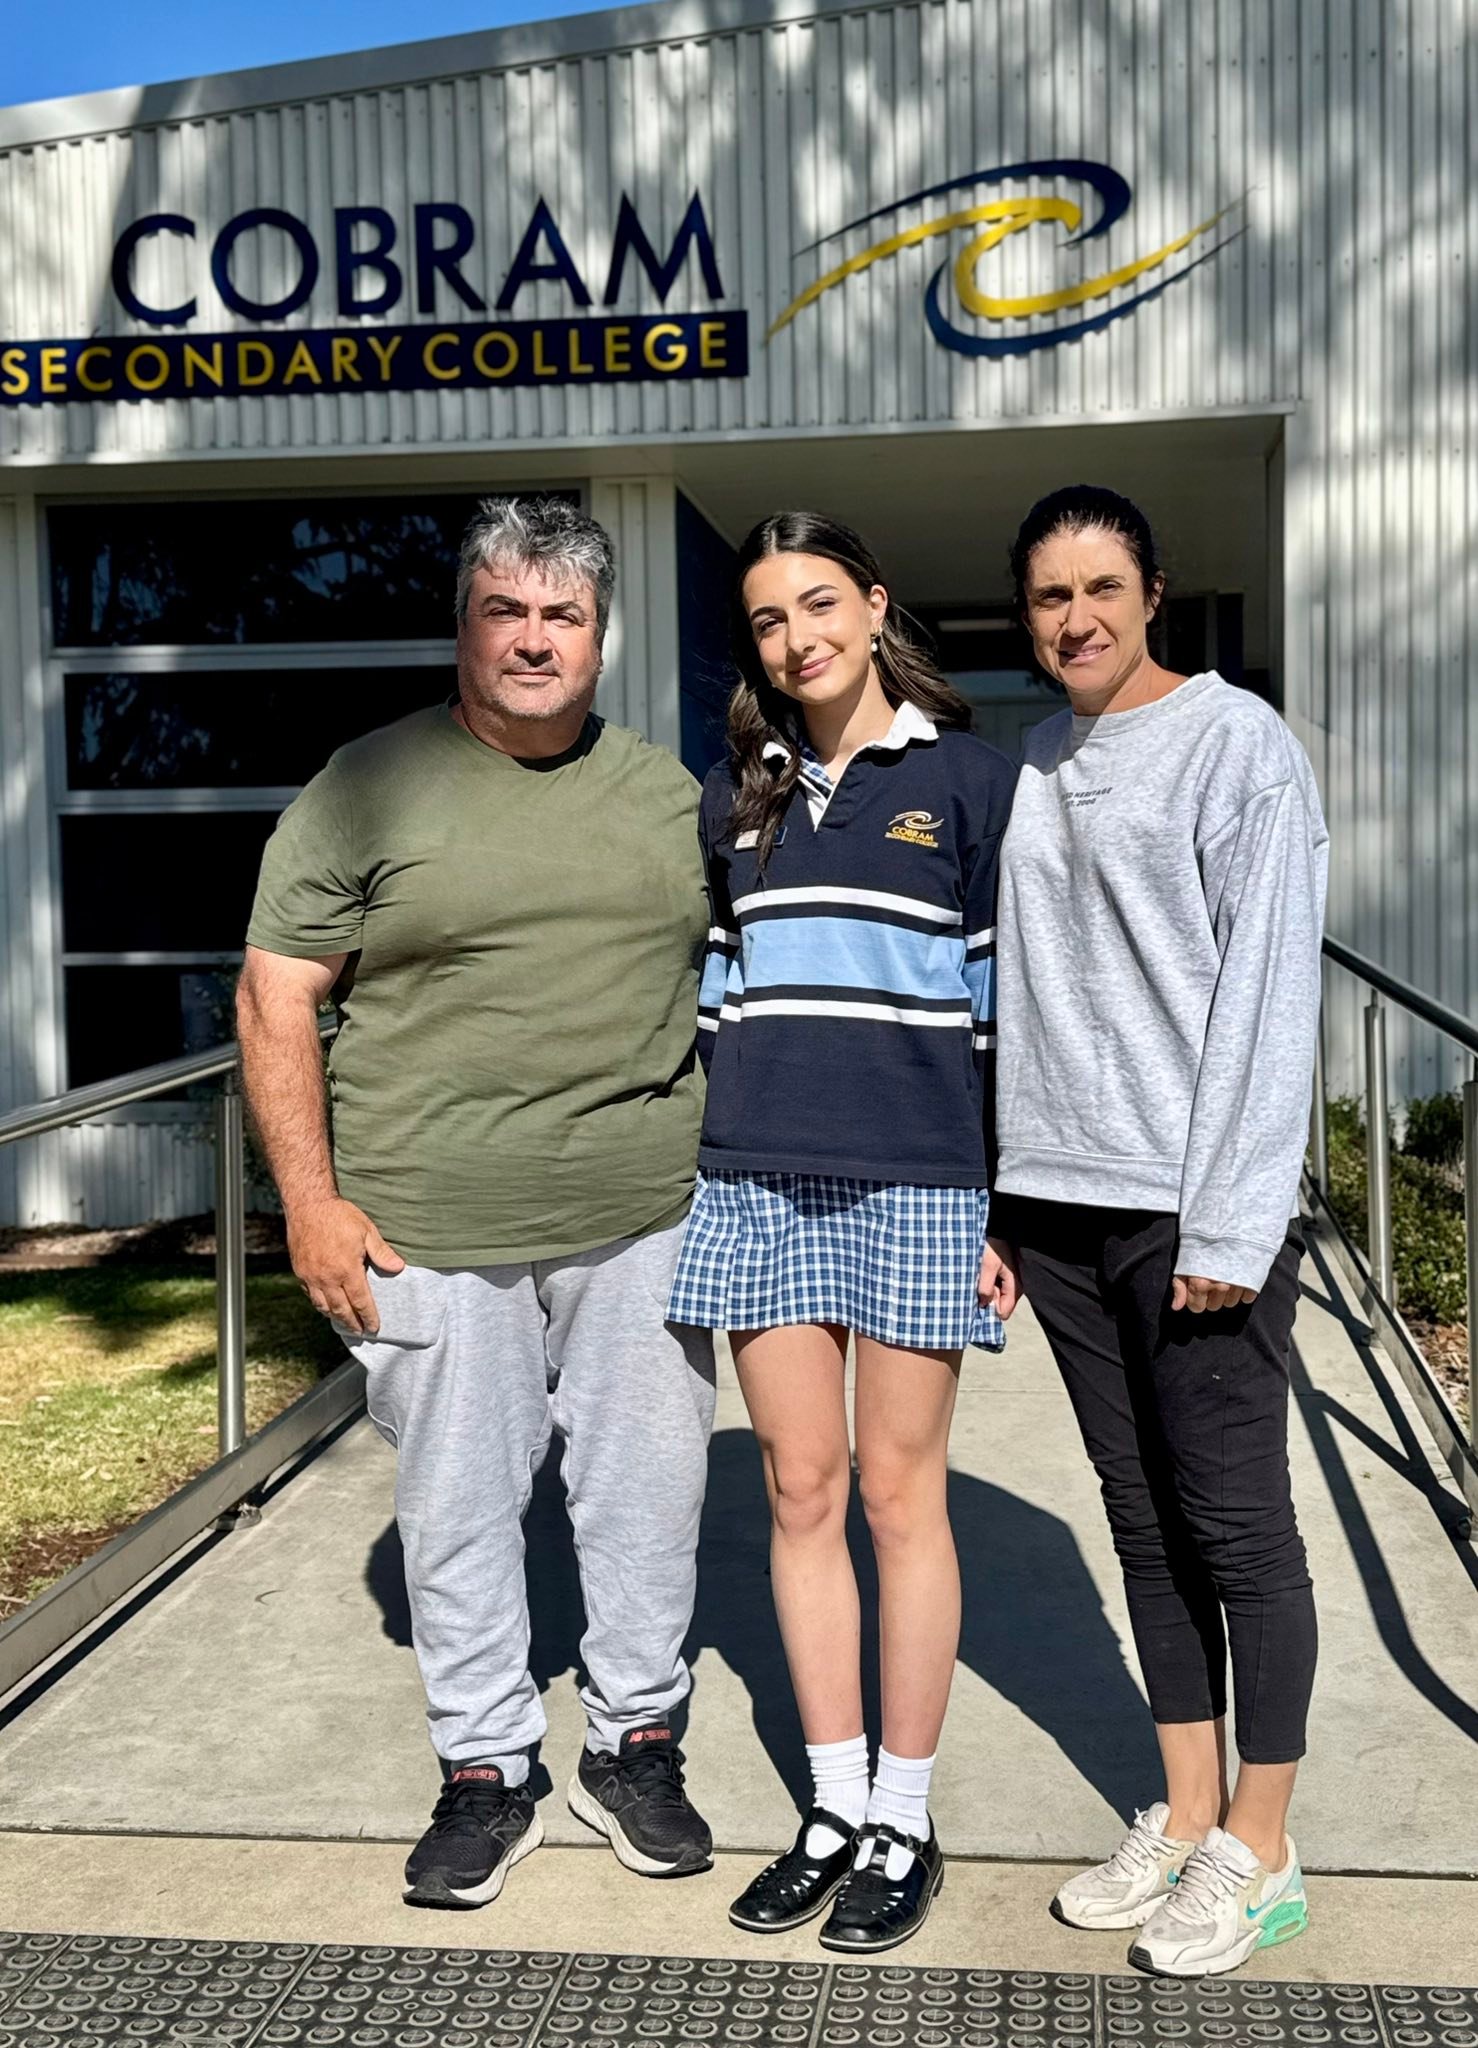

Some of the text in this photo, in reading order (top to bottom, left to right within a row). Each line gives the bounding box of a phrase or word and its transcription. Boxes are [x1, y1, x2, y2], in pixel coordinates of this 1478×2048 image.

[111, 190, 725, 325] COBRAM
[1, 322, 727, 396] SECONDARY COLLEGE
[892, 826, 934, 842] COBRAM
